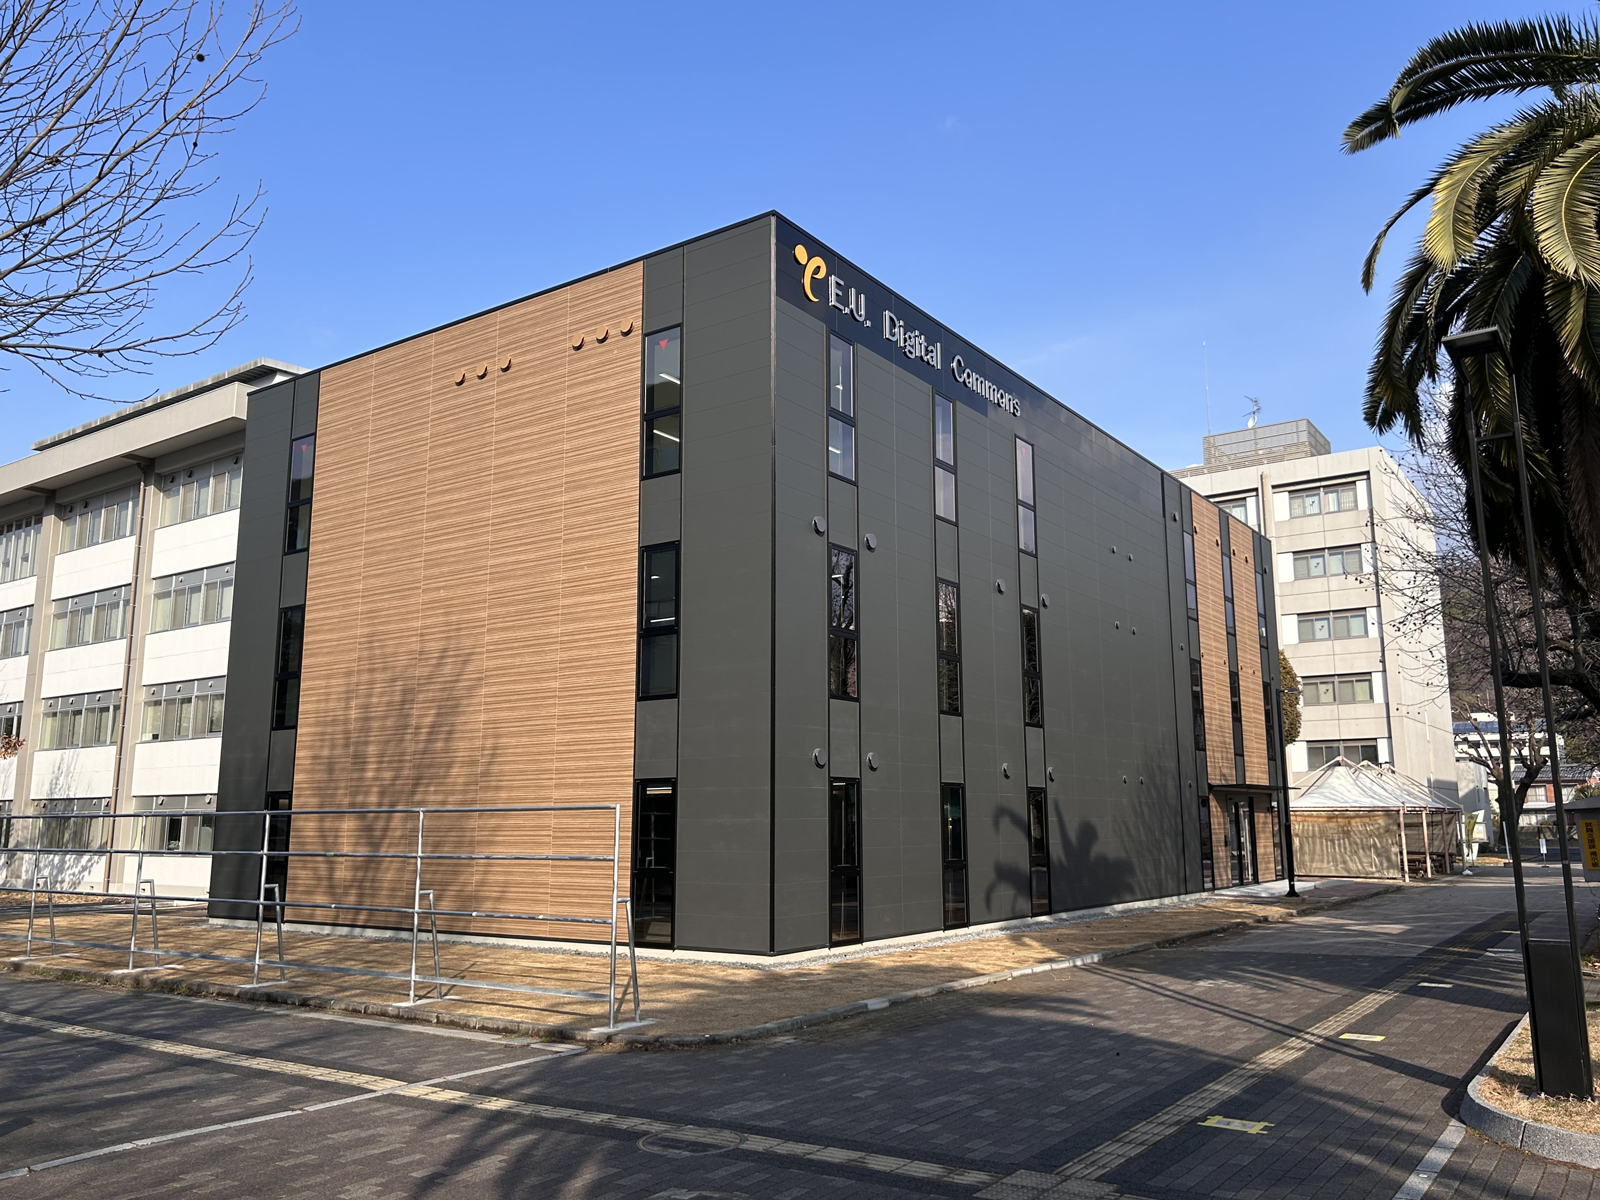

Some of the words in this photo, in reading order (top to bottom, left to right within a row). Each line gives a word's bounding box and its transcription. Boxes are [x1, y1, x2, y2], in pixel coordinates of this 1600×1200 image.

[829, 274, 871, 328] E.U.
[883, 309, 941, 370] Digital
[951, 354, 1021, 417] Commons
